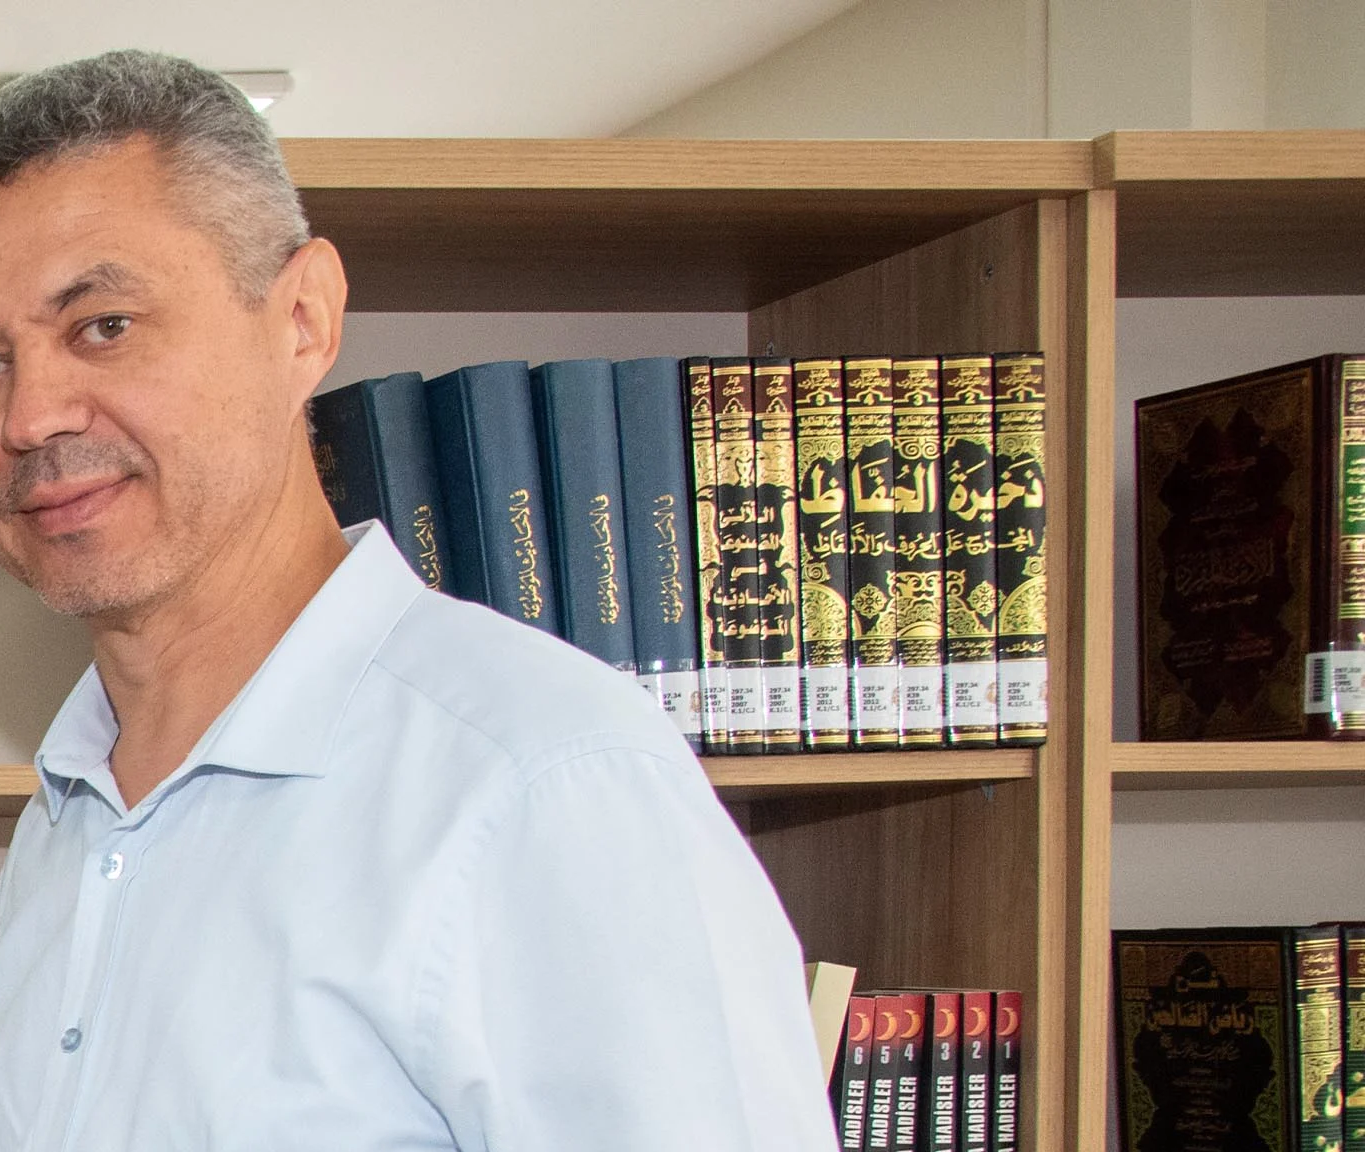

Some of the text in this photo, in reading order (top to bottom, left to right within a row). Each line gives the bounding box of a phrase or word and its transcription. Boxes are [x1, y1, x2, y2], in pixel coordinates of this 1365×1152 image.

[854, 1046, 863, 1065] 6
[880, 1046, 890, 1064] 5
[904, 1043, 914, 1062] 4
[940, 1042, 950, 1061] 3
[972, 1040, 982, 1060] 2
[1004, 1041, 1010, 1060] 1
[870, 1078, 892, 1148] HADİSLER
[896, 1076, 917, 1145] HADİSLER
[933, 1075, 954, 1145] HADİSLER
[966, 1073, 986, 1144] HADİSLER
[997, 1073, 1017, 1143] HADİSLER
